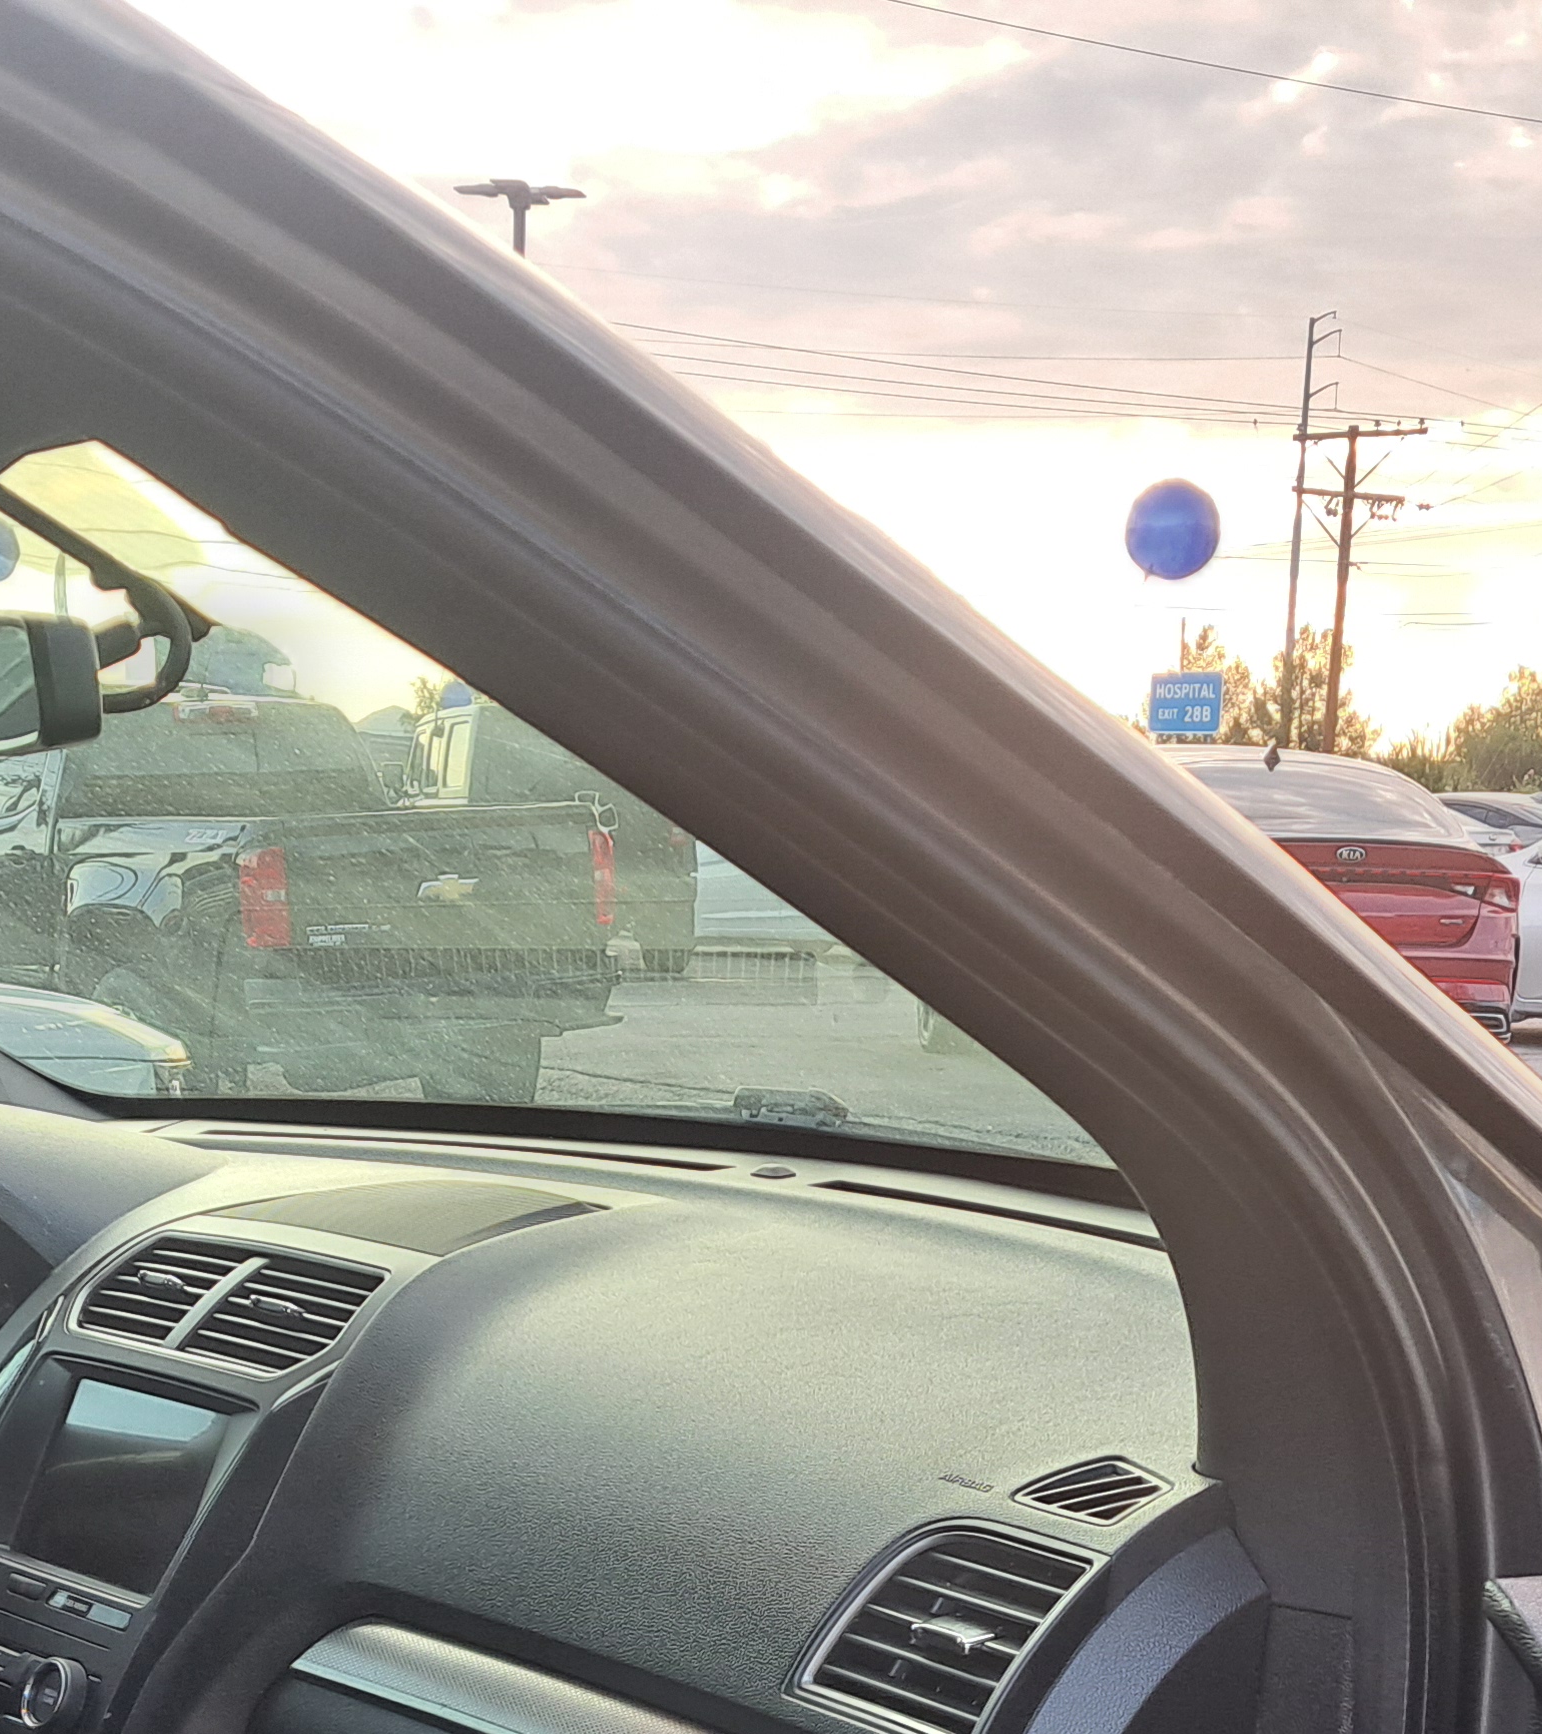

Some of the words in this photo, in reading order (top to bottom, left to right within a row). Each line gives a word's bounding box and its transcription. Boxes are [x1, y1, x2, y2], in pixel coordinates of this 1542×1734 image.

[1156, 683, 1216, 699] HOSPITAL
[1158, 708, 1179, 720] EXIT
[1184, 705, 1212, 722] 28B
[1341, 850, 1361, 860] KIA
